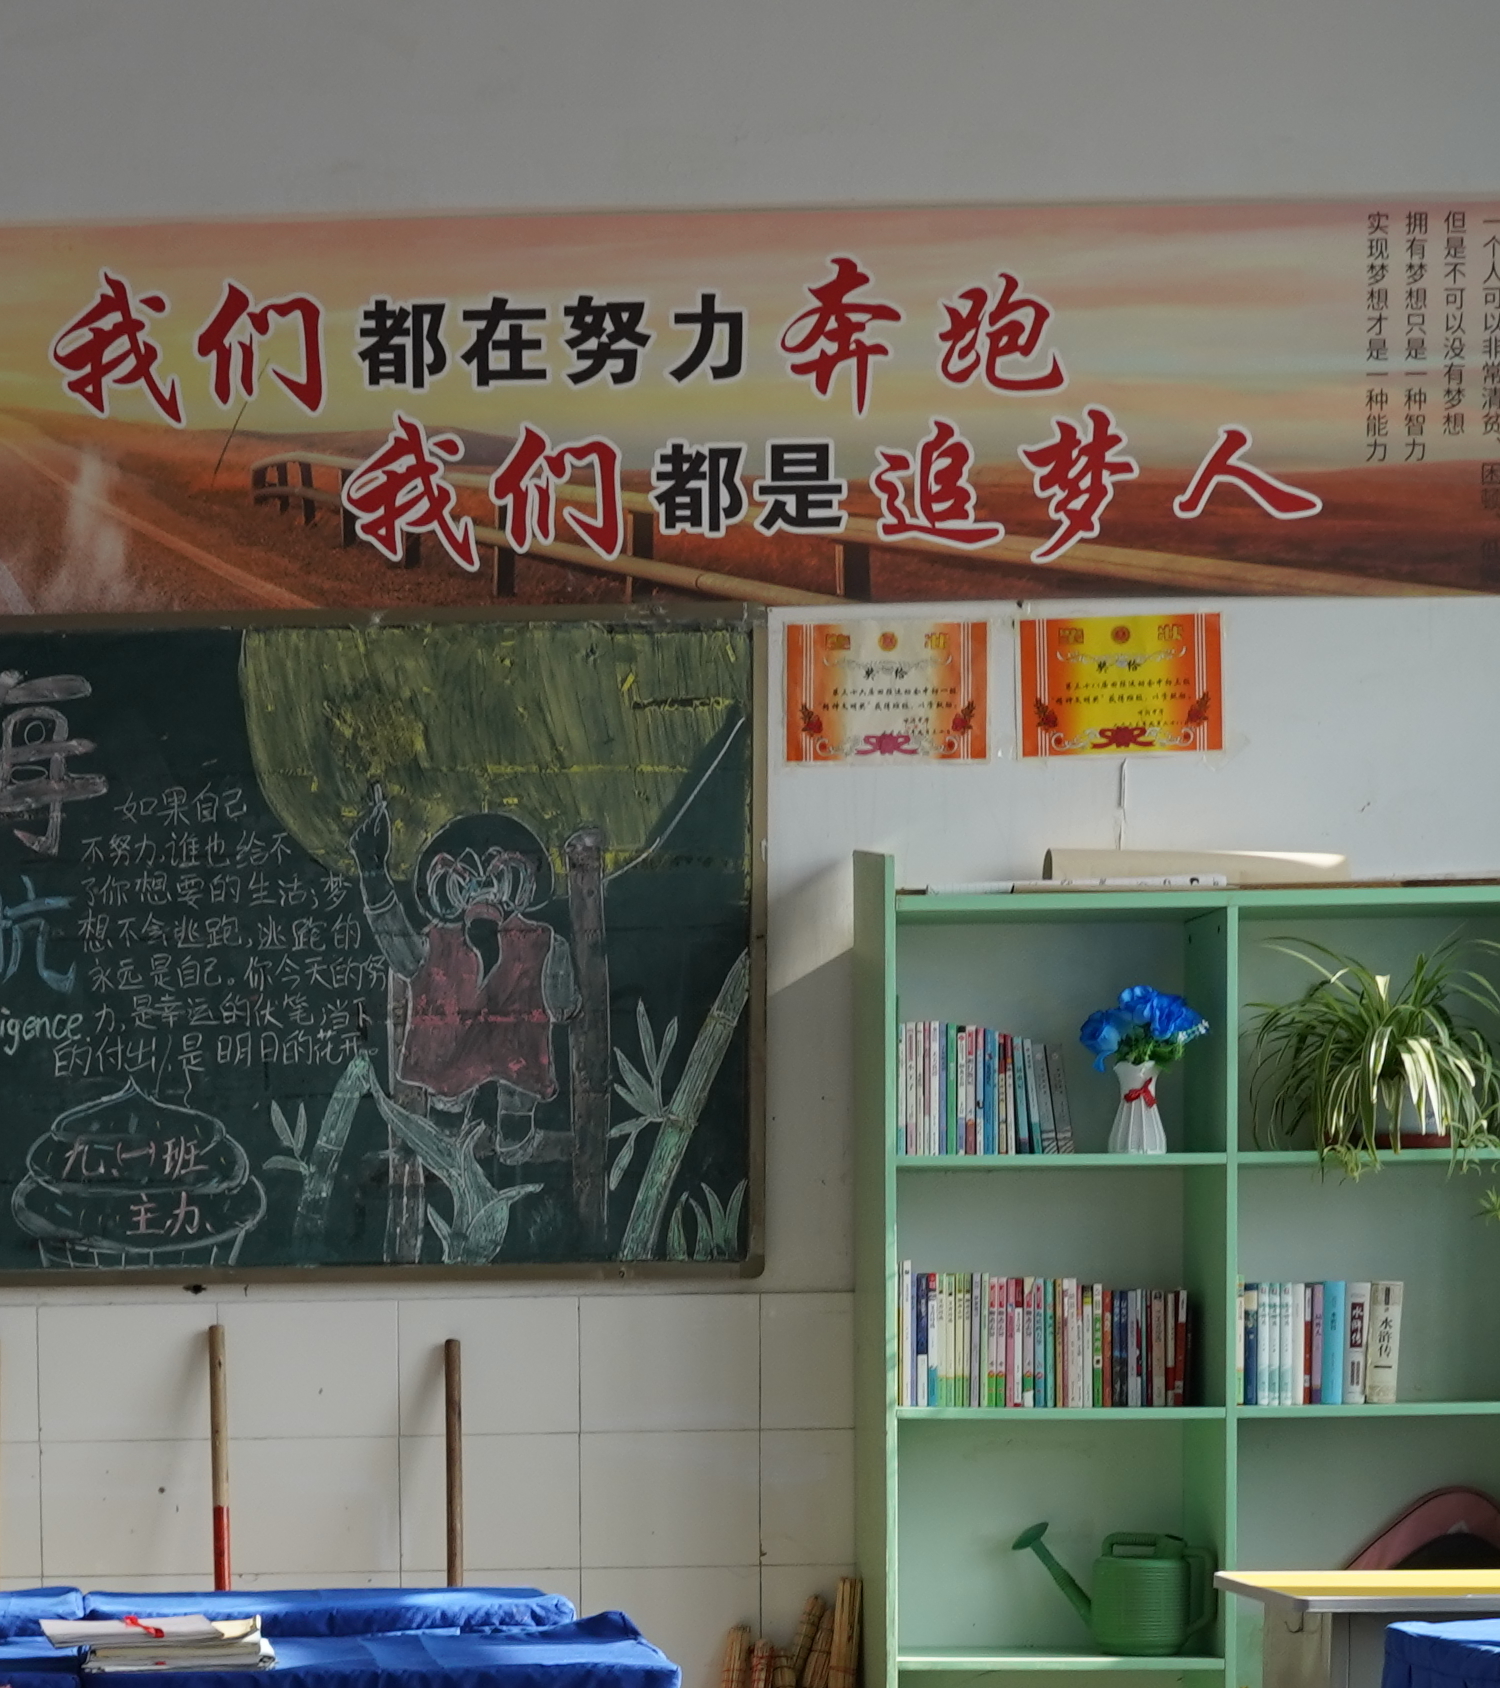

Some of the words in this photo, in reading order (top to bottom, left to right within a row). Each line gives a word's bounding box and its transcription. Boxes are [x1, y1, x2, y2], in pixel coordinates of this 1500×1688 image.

[48, 254, 1066, 427] 我们都在努力奔跑
[1366, 210, 1390, 462] 实现梦想才是一种能力
[1404, 210, 1428, 462] 拥有梦想只是一种智力
[1443, 210, 1467, 435] 但是不可以没有梦想
[341, 404, 1322, 574] 我们都是追梦人
[114, 783, 248, 826] 如果自己
[1377, 1316, 1394, 1359] 水浒传
